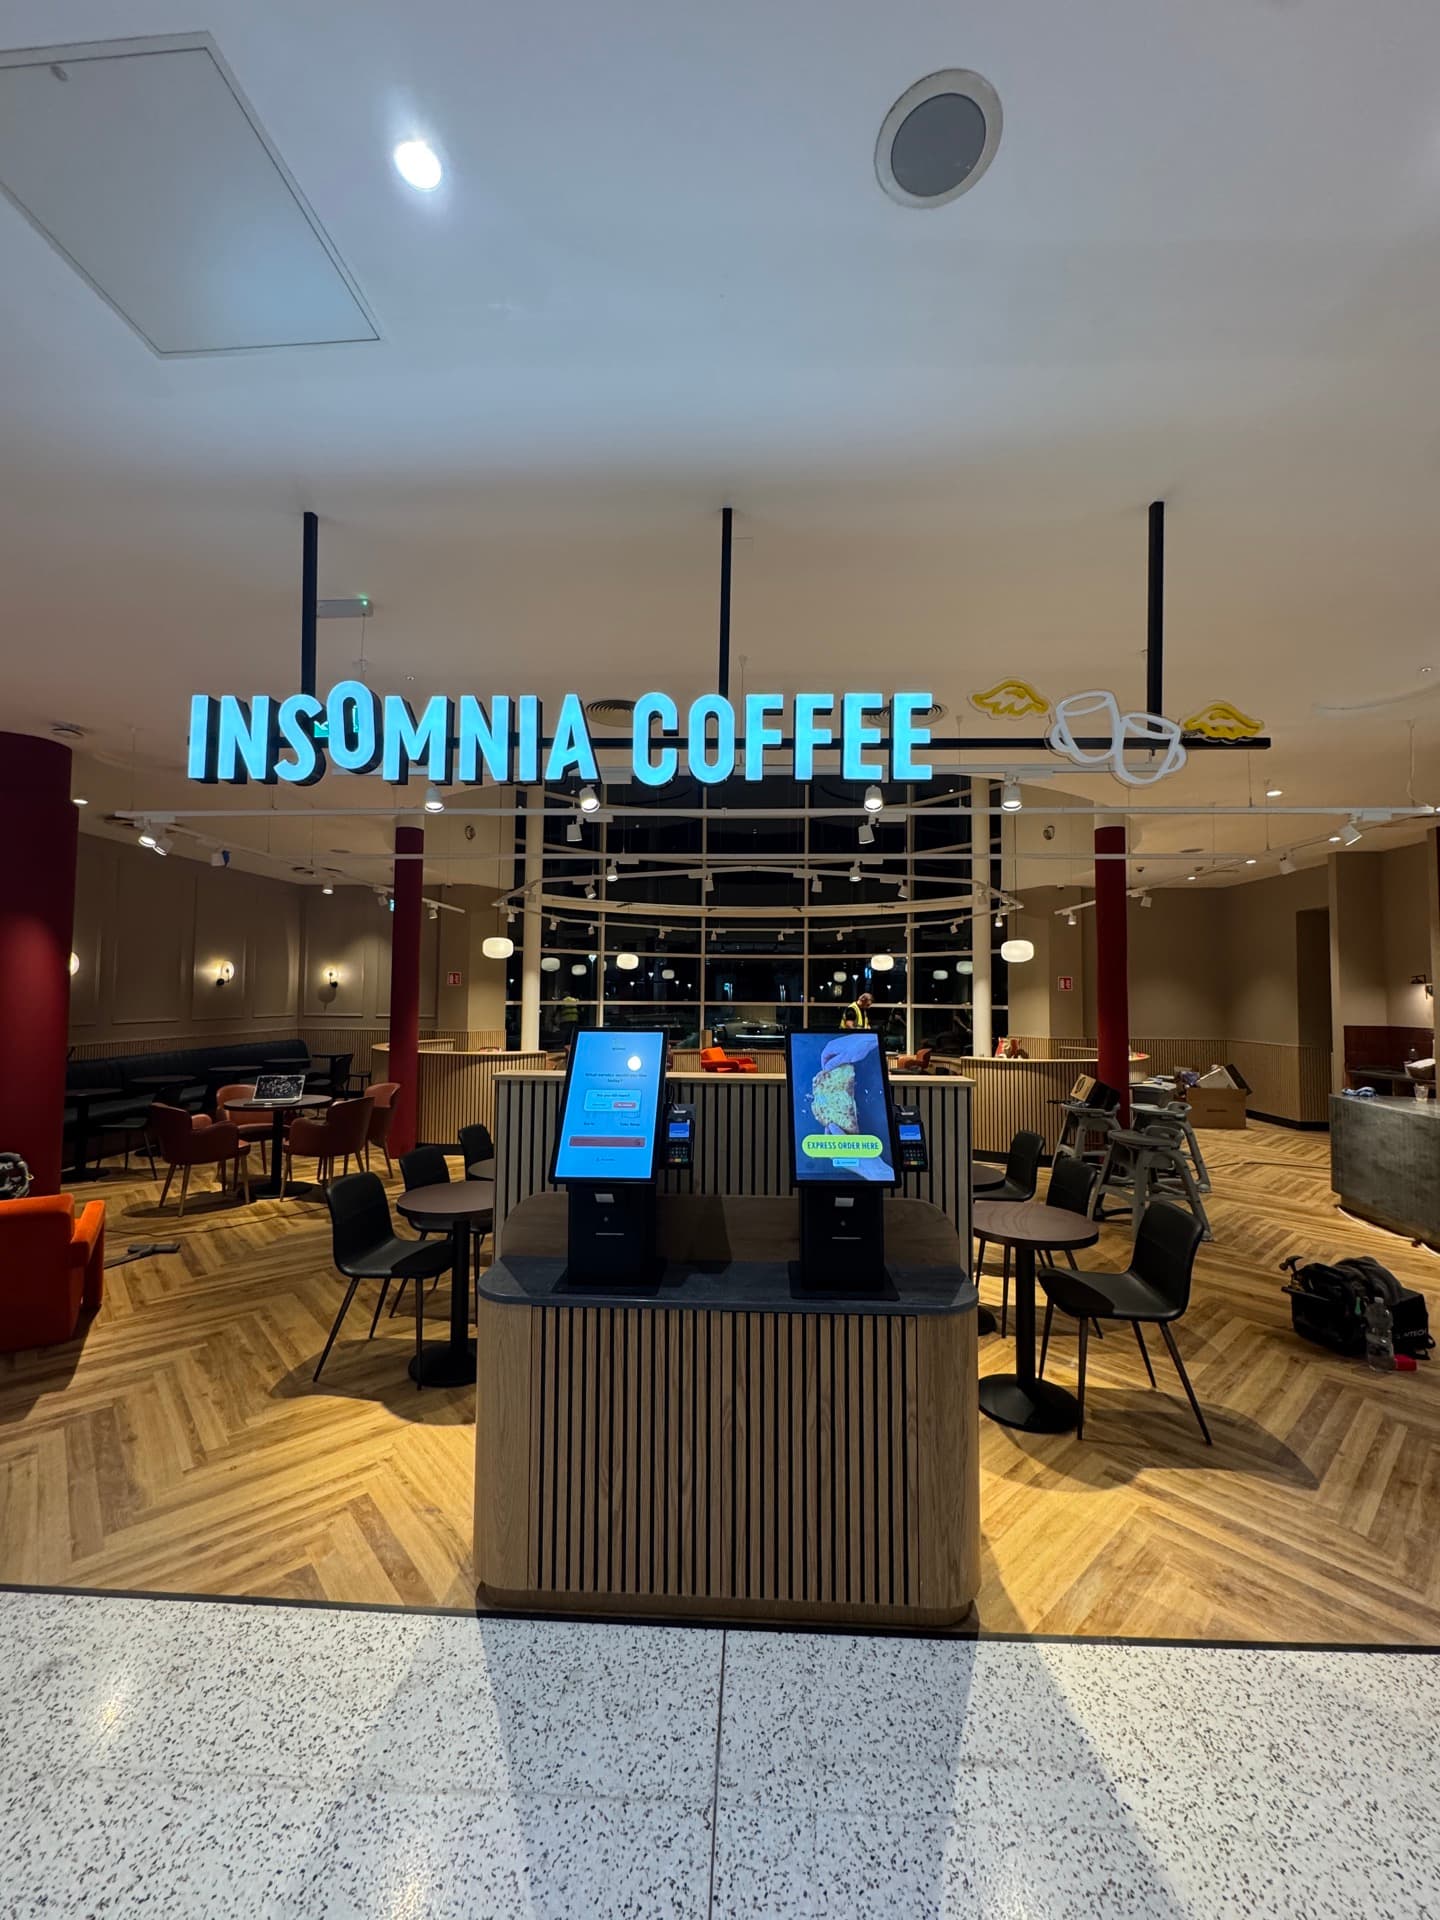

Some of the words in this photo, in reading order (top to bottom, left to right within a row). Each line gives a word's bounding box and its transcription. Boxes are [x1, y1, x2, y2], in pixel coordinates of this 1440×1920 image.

[188, 681, 597, 784] INSOMNIA
[632, 691, 933, 785] COFFEE
[807, 1141, 837, 1150] EXPRESS
[837, 1141, 860, 1150] ORDER
[861, 1141, 879, 1150] HERE
